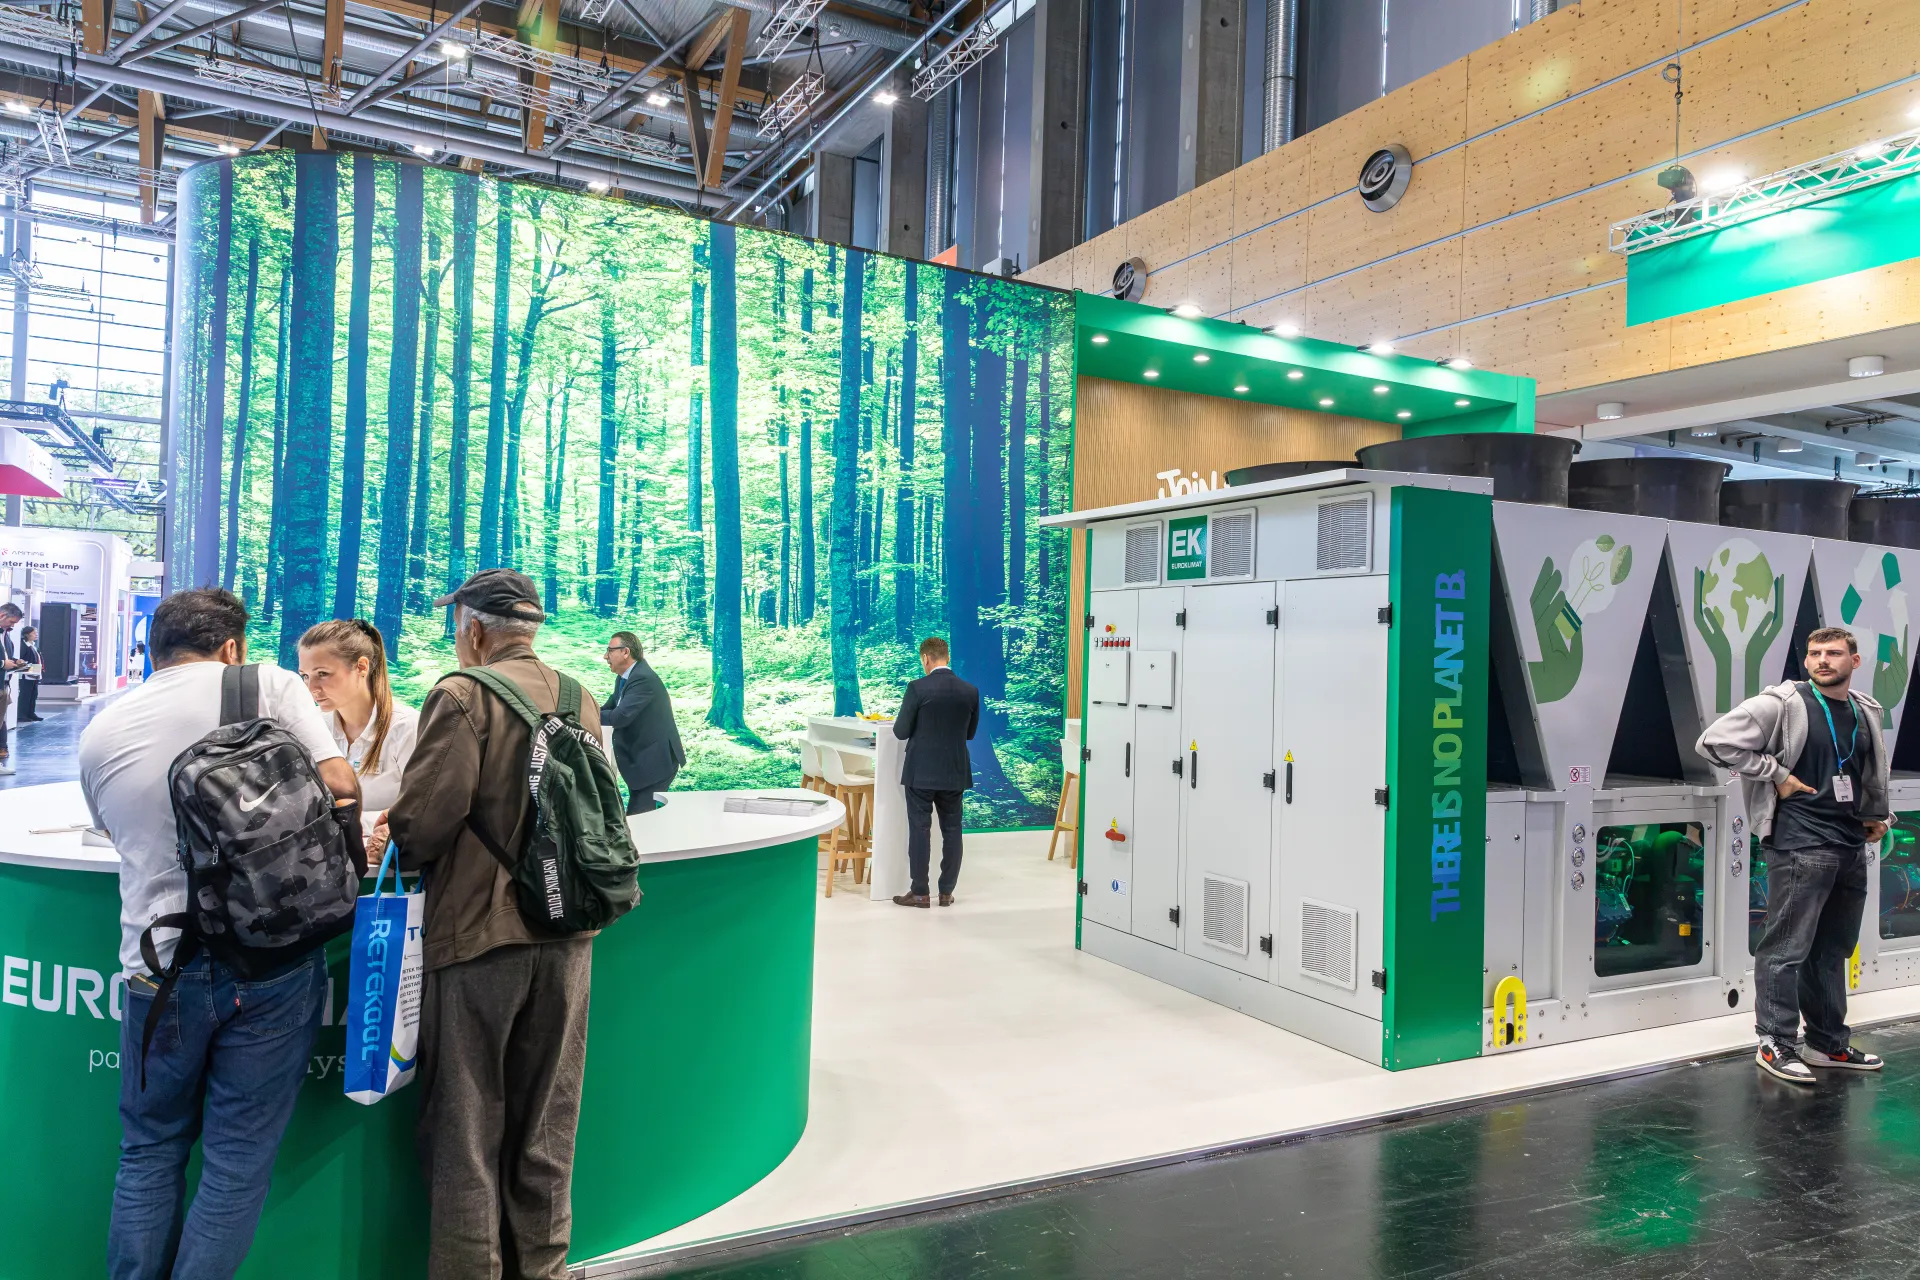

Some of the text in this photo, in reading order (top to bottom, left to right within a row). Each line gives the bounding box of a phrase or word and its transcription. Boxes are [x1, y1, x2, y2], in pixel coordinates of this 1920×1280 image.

[1171, 527, 1203, 558] EK
[25, 561, 50, 569] Heat
[52, 562, 80, 571] Pump
[1171, 560, 1203, 570] EUROKLIMAT
[1433, 603, 1465, 729] PLANET
[530, 746, 548, 773] JUST
[1433, 733, 1463, 786] NO
[542, 858, 564, 920] INSPIRING FUTURE
[1430, 821, 1462, 922] THERE
